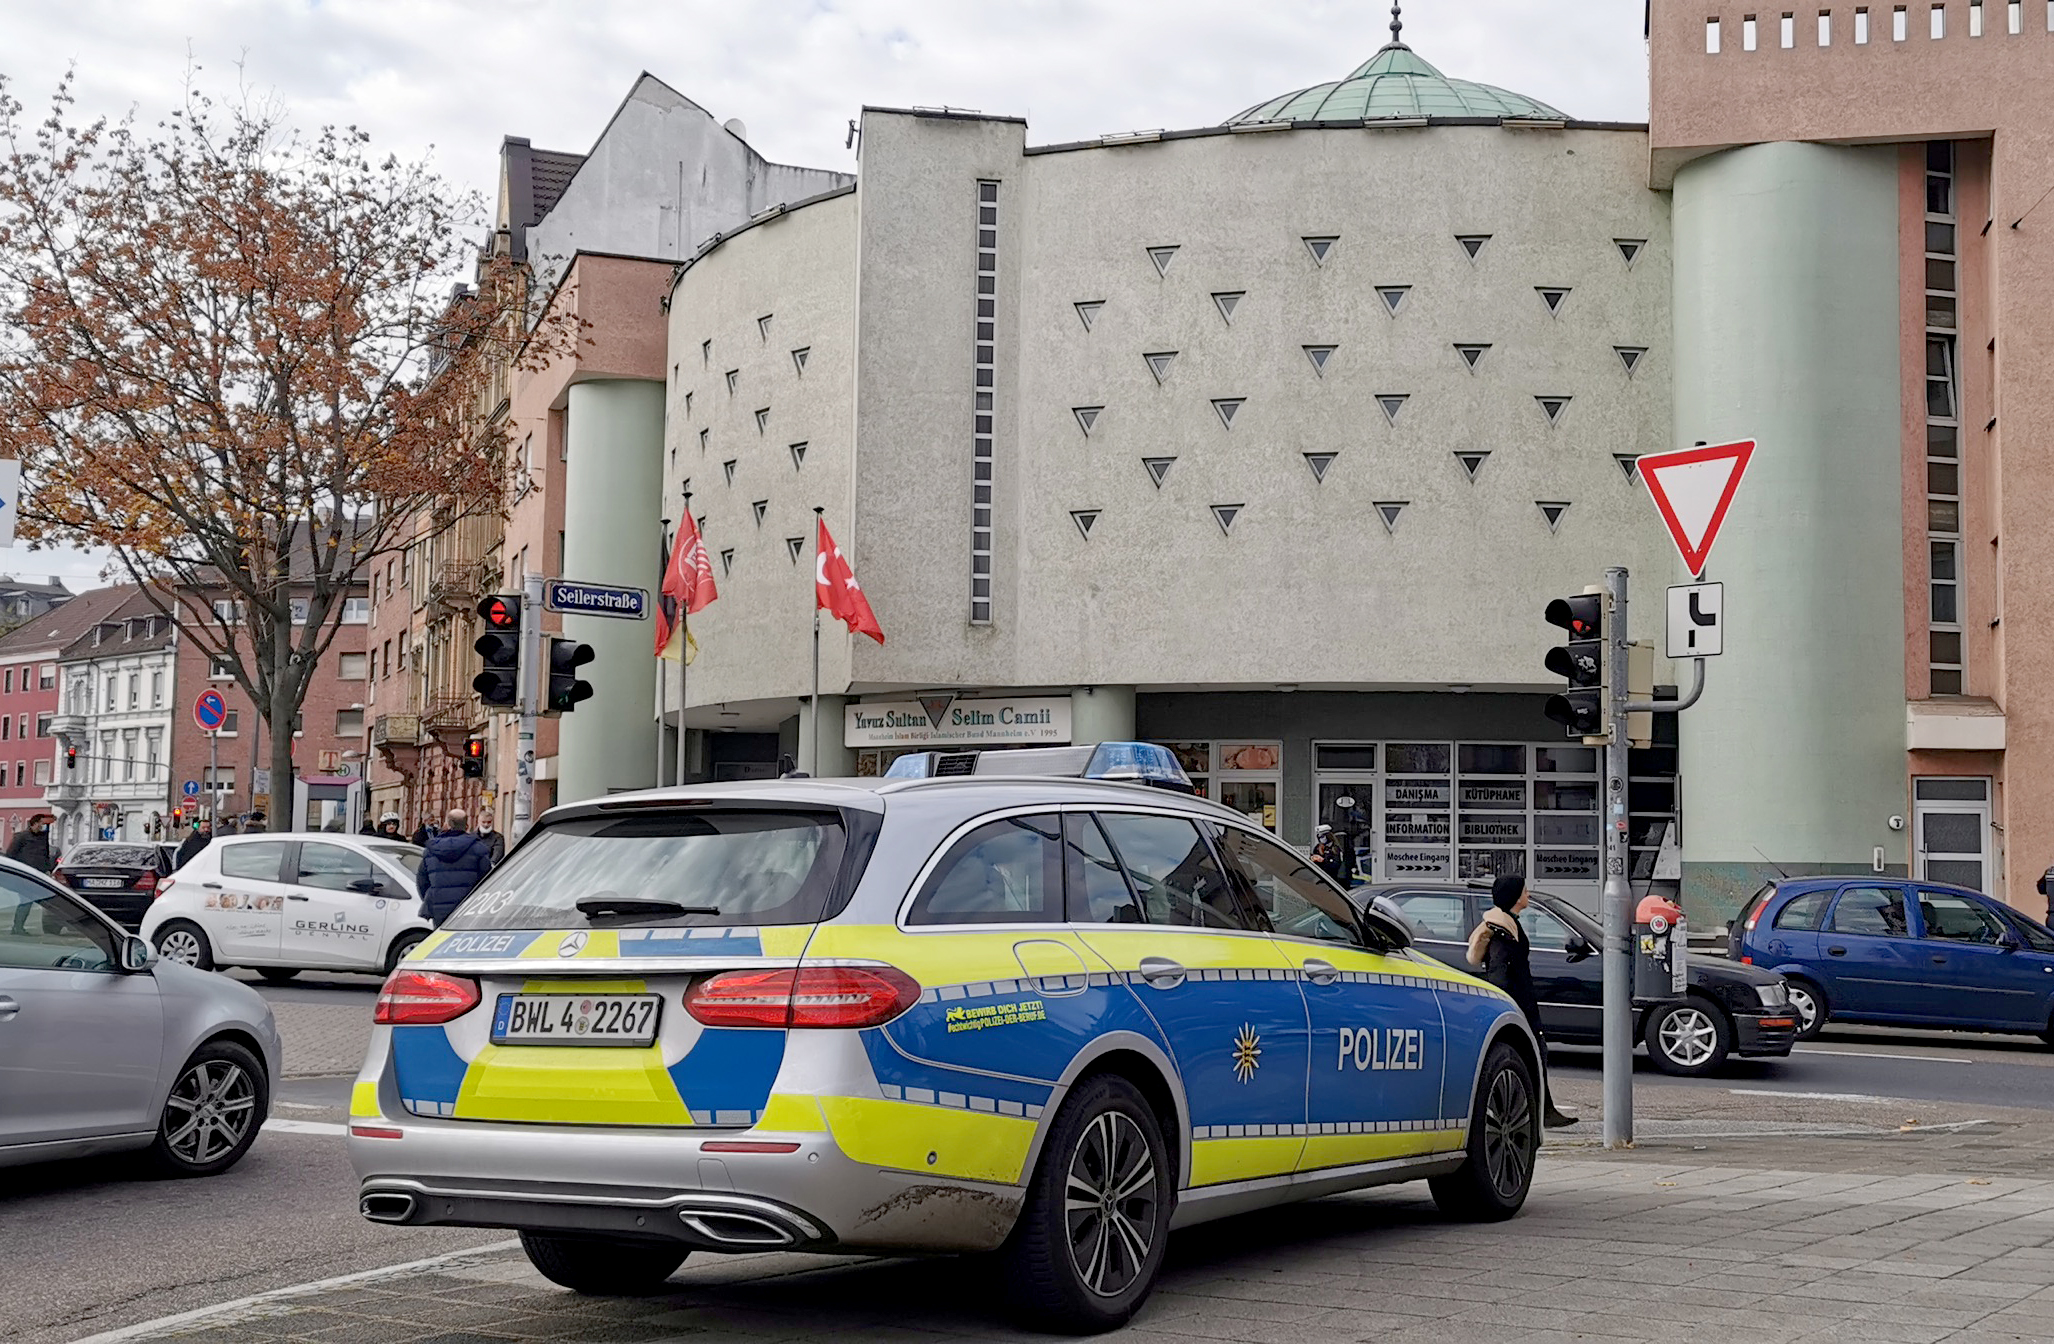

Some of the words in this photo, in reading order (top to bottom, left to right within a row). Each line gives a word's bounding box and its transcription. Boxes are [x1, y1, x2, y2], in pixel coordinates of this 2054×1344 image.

[557, 587, 638, 610] Seilerstraße
[854, 712, 884, 729] Yavuz
[886, 711, 927, 727] Sultan
[951, 708, 995, 726] Selim
[999, 706, 1051, 725] Camii
[966, 729, 985, 738] Bund
[985, 728, 1023, 738] Mannheim
[1040, 728, 1058, 737] 1995
[1395, 789, 1439, 802] DANIŞMA
[1465, 788, 1521, 801] KÜTÜPHANE
[1386, 823, 1450, 834] INFORMATION
[1464, 824, 1519, 836] BIBLIOTHEK
[1387, 852, 1418, 862] Moschee
[1419, 852, 1450, 864] Eingang
[1536, 854, 1567, 864] Moschee
[1568, 855, 1598, 866] Eingang
[296, 920, 369, 933] GERLING
[294, 930, 369, 941] DENTAL
[443, 935, 516, 954] POLIZEI
[966, 1006, 997, 1018] BEWIRB
[997, 1003, 1017, 1013] DICH
[1019, 1000, 1044, 1011] JETZT!
[510, 1001, 553, 1033] BWL
[560, 1001, 573, 1033] 4
[590, 1001, 654, 1034] 2267
[1337, 1027, 1424, 1071] POLIZEI
